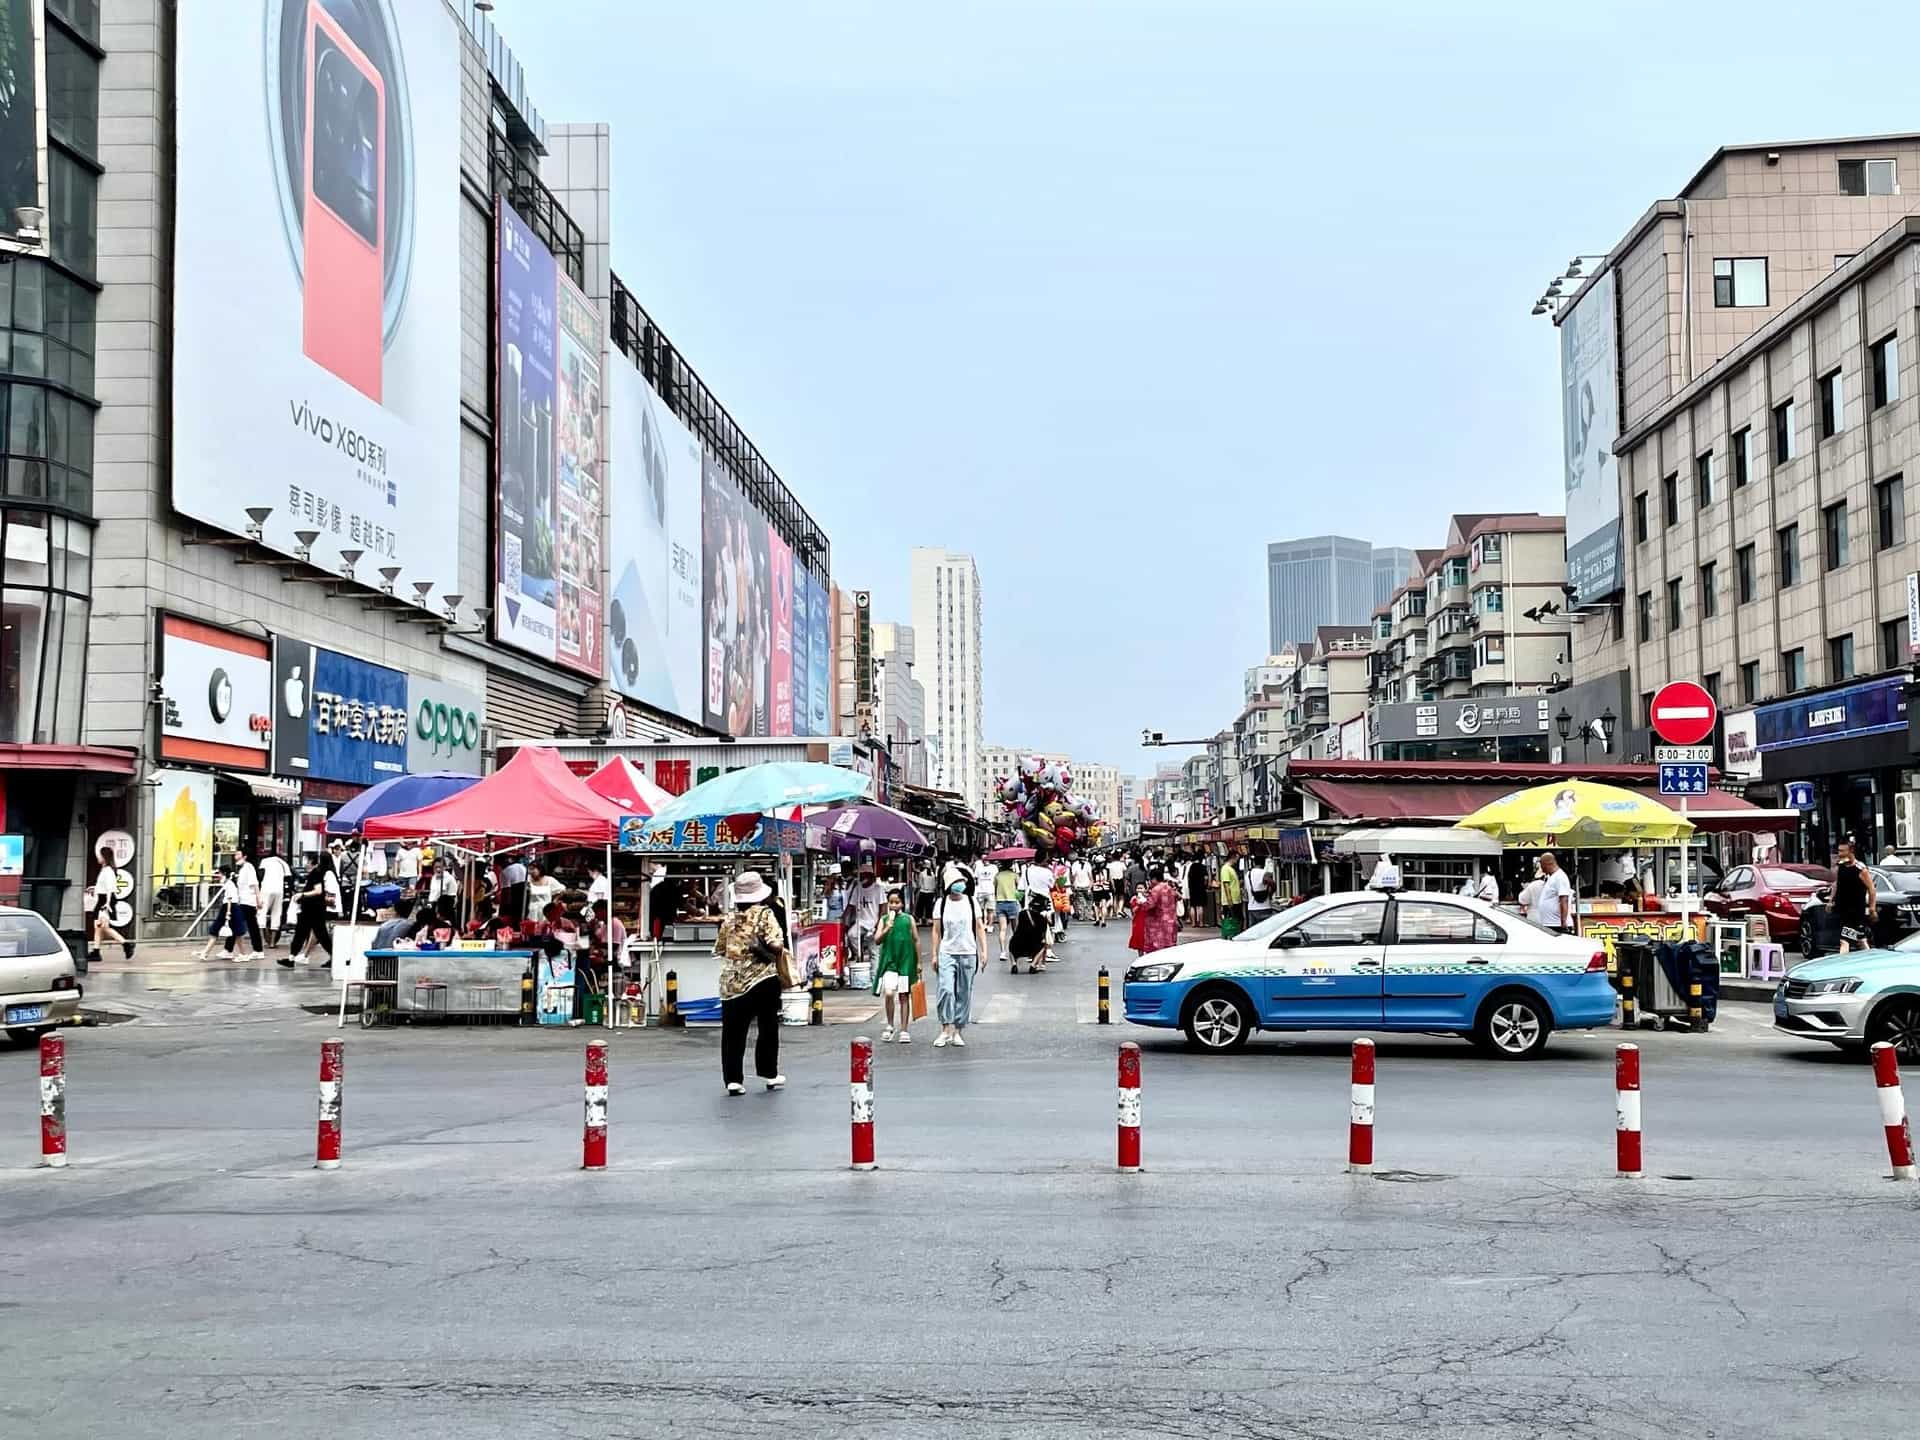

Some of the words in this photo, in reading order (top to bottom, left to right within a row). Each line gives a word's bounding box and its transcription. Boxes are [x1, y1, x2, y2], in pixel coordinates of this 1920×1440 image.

[290, 399, 333, 443] vivo
[289, 484, 342, 534] 蔡司影像
[350, 514, 396, 559] 超越所见
[315, 691, 408, 746] 百和堂大药房
[1809, 706, 1845, 727] LAWSON
[1664, 767, 1704, 778] 车让人
[1664, 780, 1704, 791] 人快走
